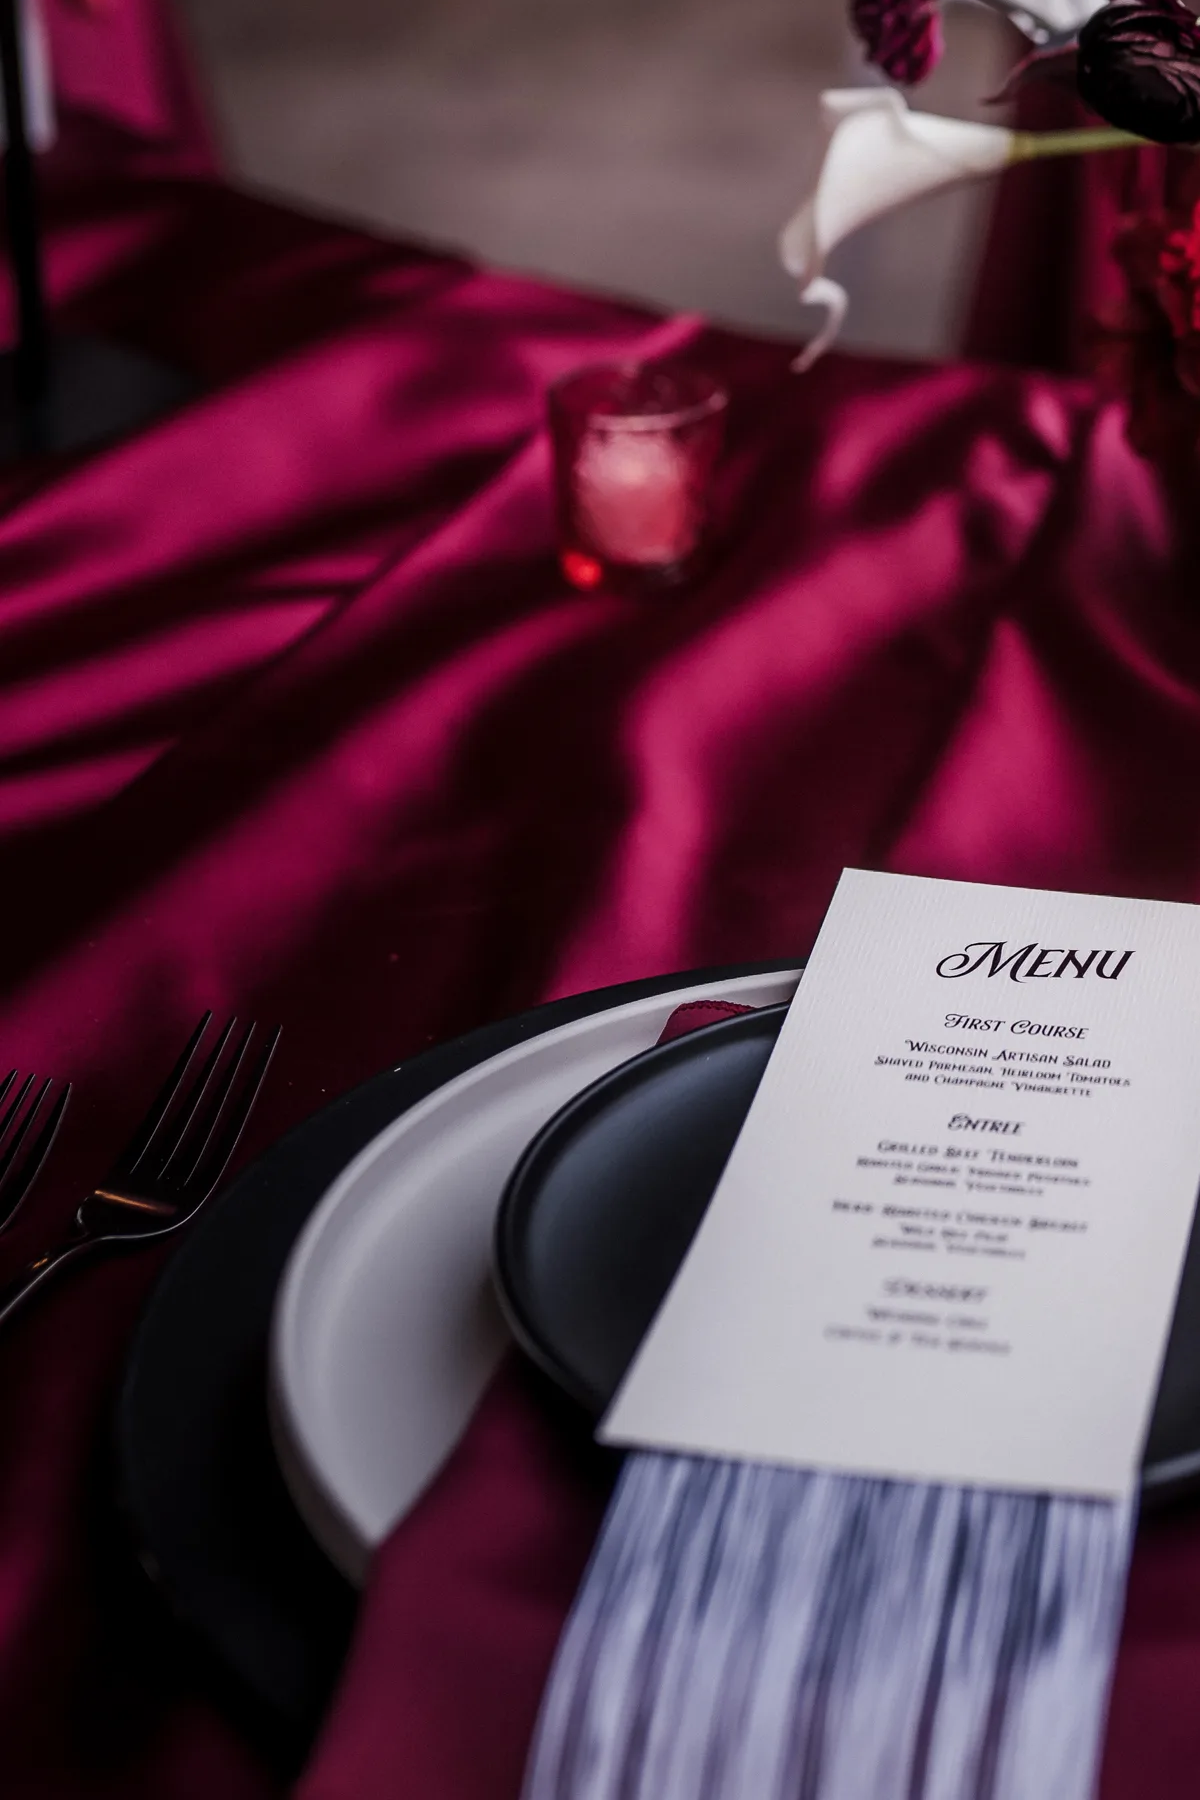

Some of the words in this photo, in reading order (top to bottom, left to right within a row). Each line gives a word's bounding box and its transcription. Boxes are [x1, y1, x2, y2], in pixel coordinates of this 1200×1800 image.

[936, 941, 1136, 983] MENU
[944, 1013, 1006, 1034] FIRST
[1010, 1019, 1089, 1040] COURSE
[904, 1039, 988, 1058] WISCONSIN
[991, 1049, 1058, 1065] ARTISAN
[1062, 1054, 1111, 1070] SALAD
